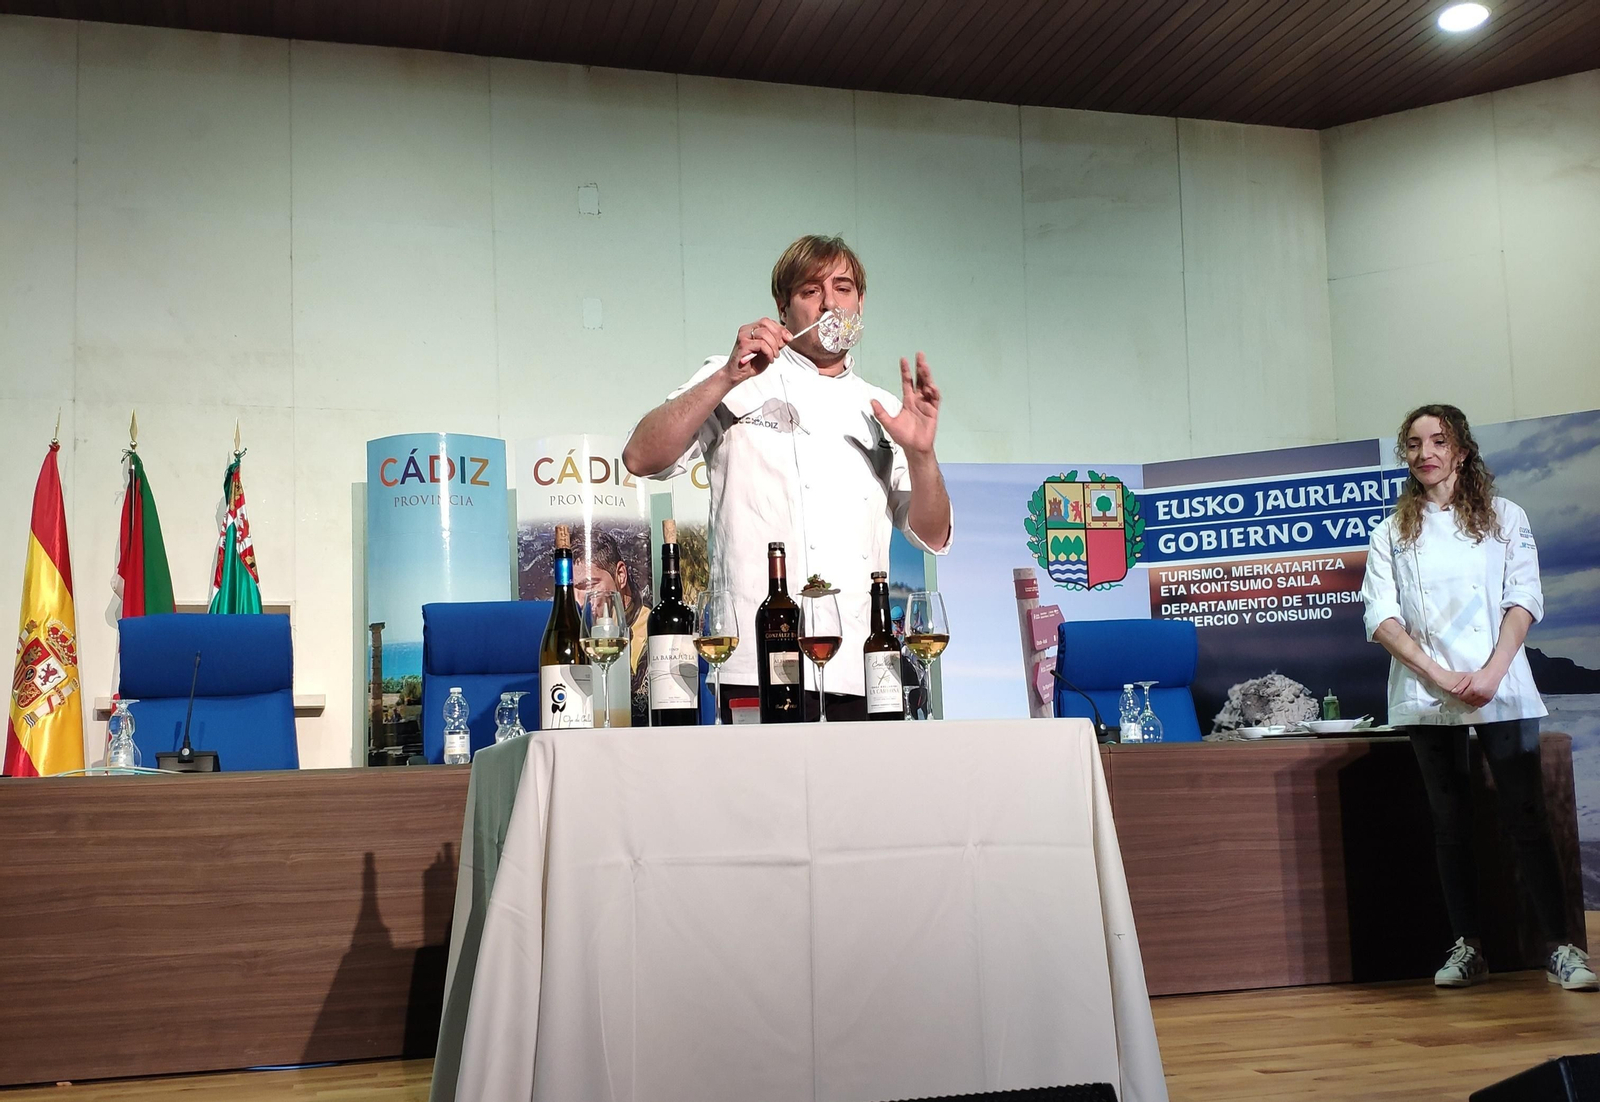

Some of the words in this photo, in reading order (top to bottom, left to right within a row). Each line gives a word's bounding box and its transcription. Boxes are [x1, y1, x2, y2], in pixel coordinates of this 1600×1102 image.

[380, 448, 490, 488] CÁDIZ
[550, 494, 626, 507] PROVNCIA
[1156, 493, 1245, 521] EUSKO
[1158, 522, 1313, 554] GOBIERNO
[1159, 567, 1228, 583] TURISMO,
[1231, 558, 1345, 578] MERKATARITZA
[1160, 585, 1187, 597] ETA
[1190, 577, 1273, 595] KONTSUMO
[1277, 574, 1321, 588] SAILA
[1161, 596, 1278, 616] DEPARTAMENTO
[1282, 595, 1303, 608] DE
[1163, 612, 1239, 627] ERCIO
[1242, 613, 1251, 624] Y
[1255, 607, 1332, 623] CONSUMO
